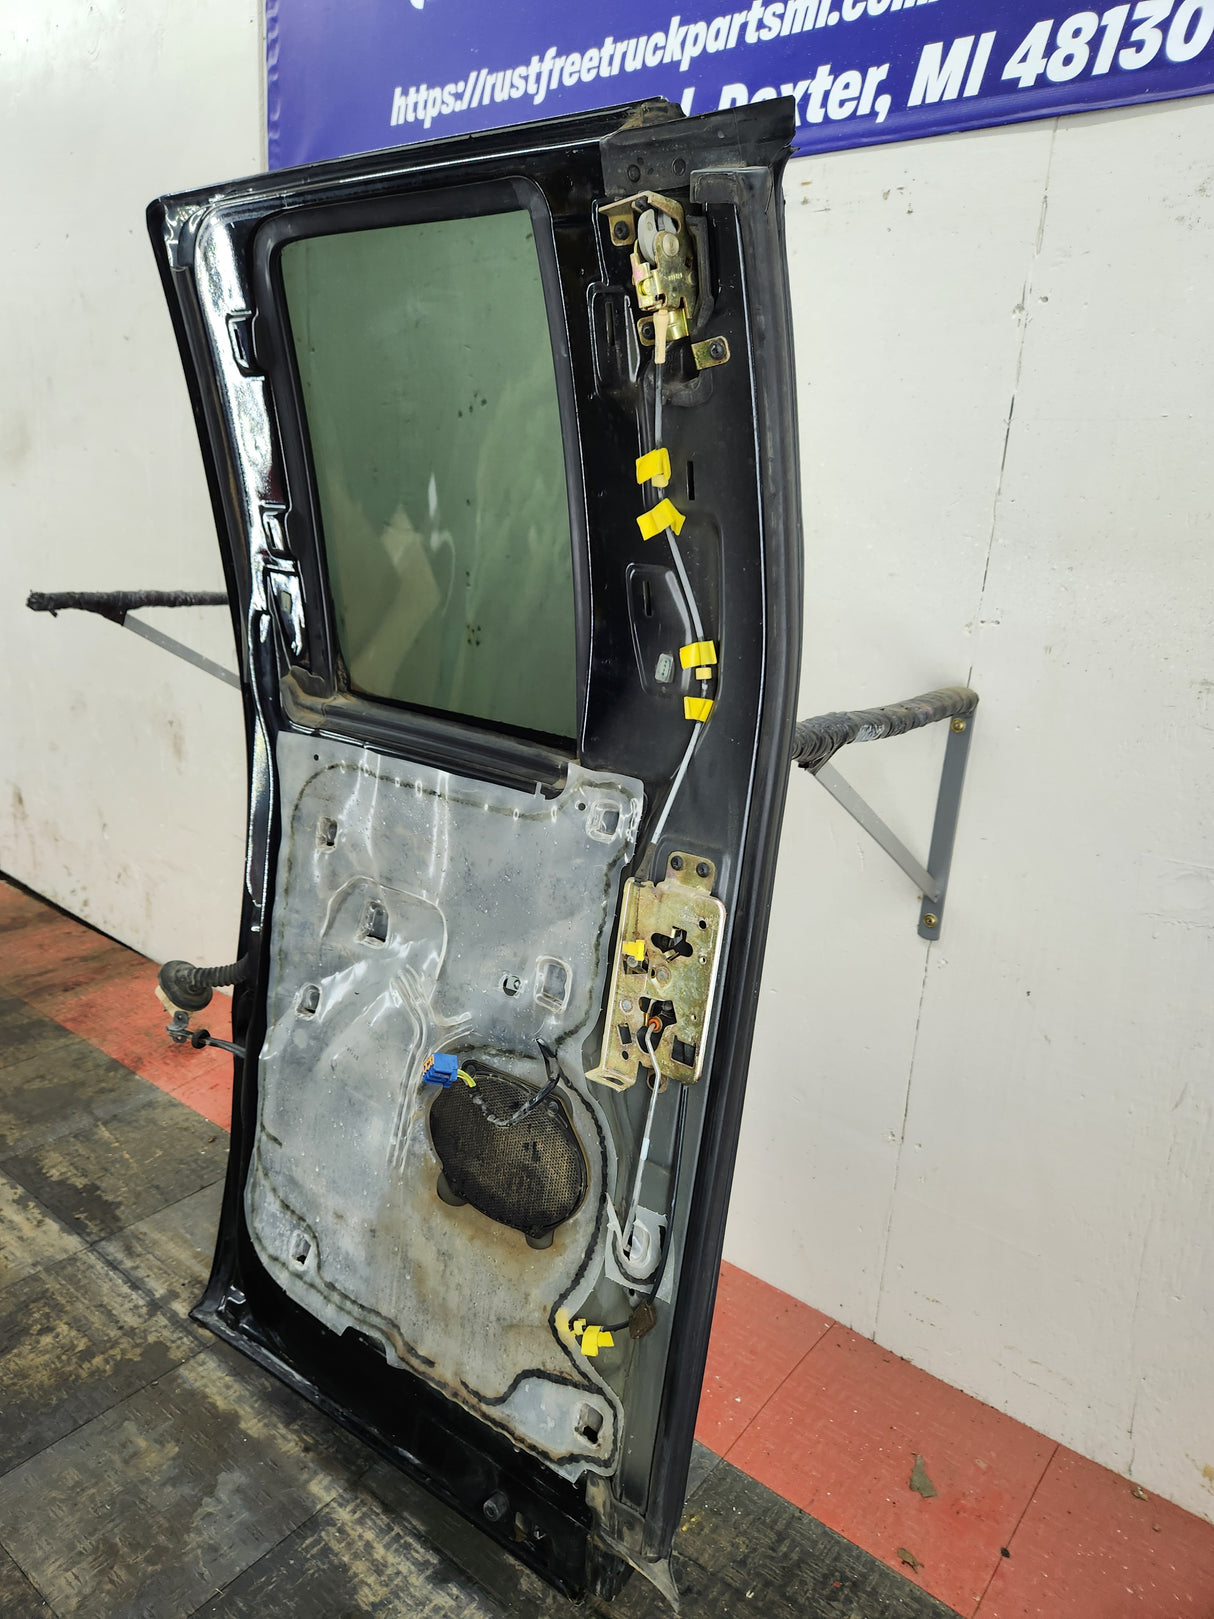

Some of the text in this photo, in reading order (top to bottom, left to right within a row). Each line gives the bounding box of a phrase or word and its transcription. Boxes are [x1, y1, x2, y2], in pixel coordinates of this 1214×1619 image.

[390, 0, 939, 130] https://rustfreetruckpartsmi.c
[907, 31, 997, 107] MI
[1001, 0, 1214, 89] 48130
